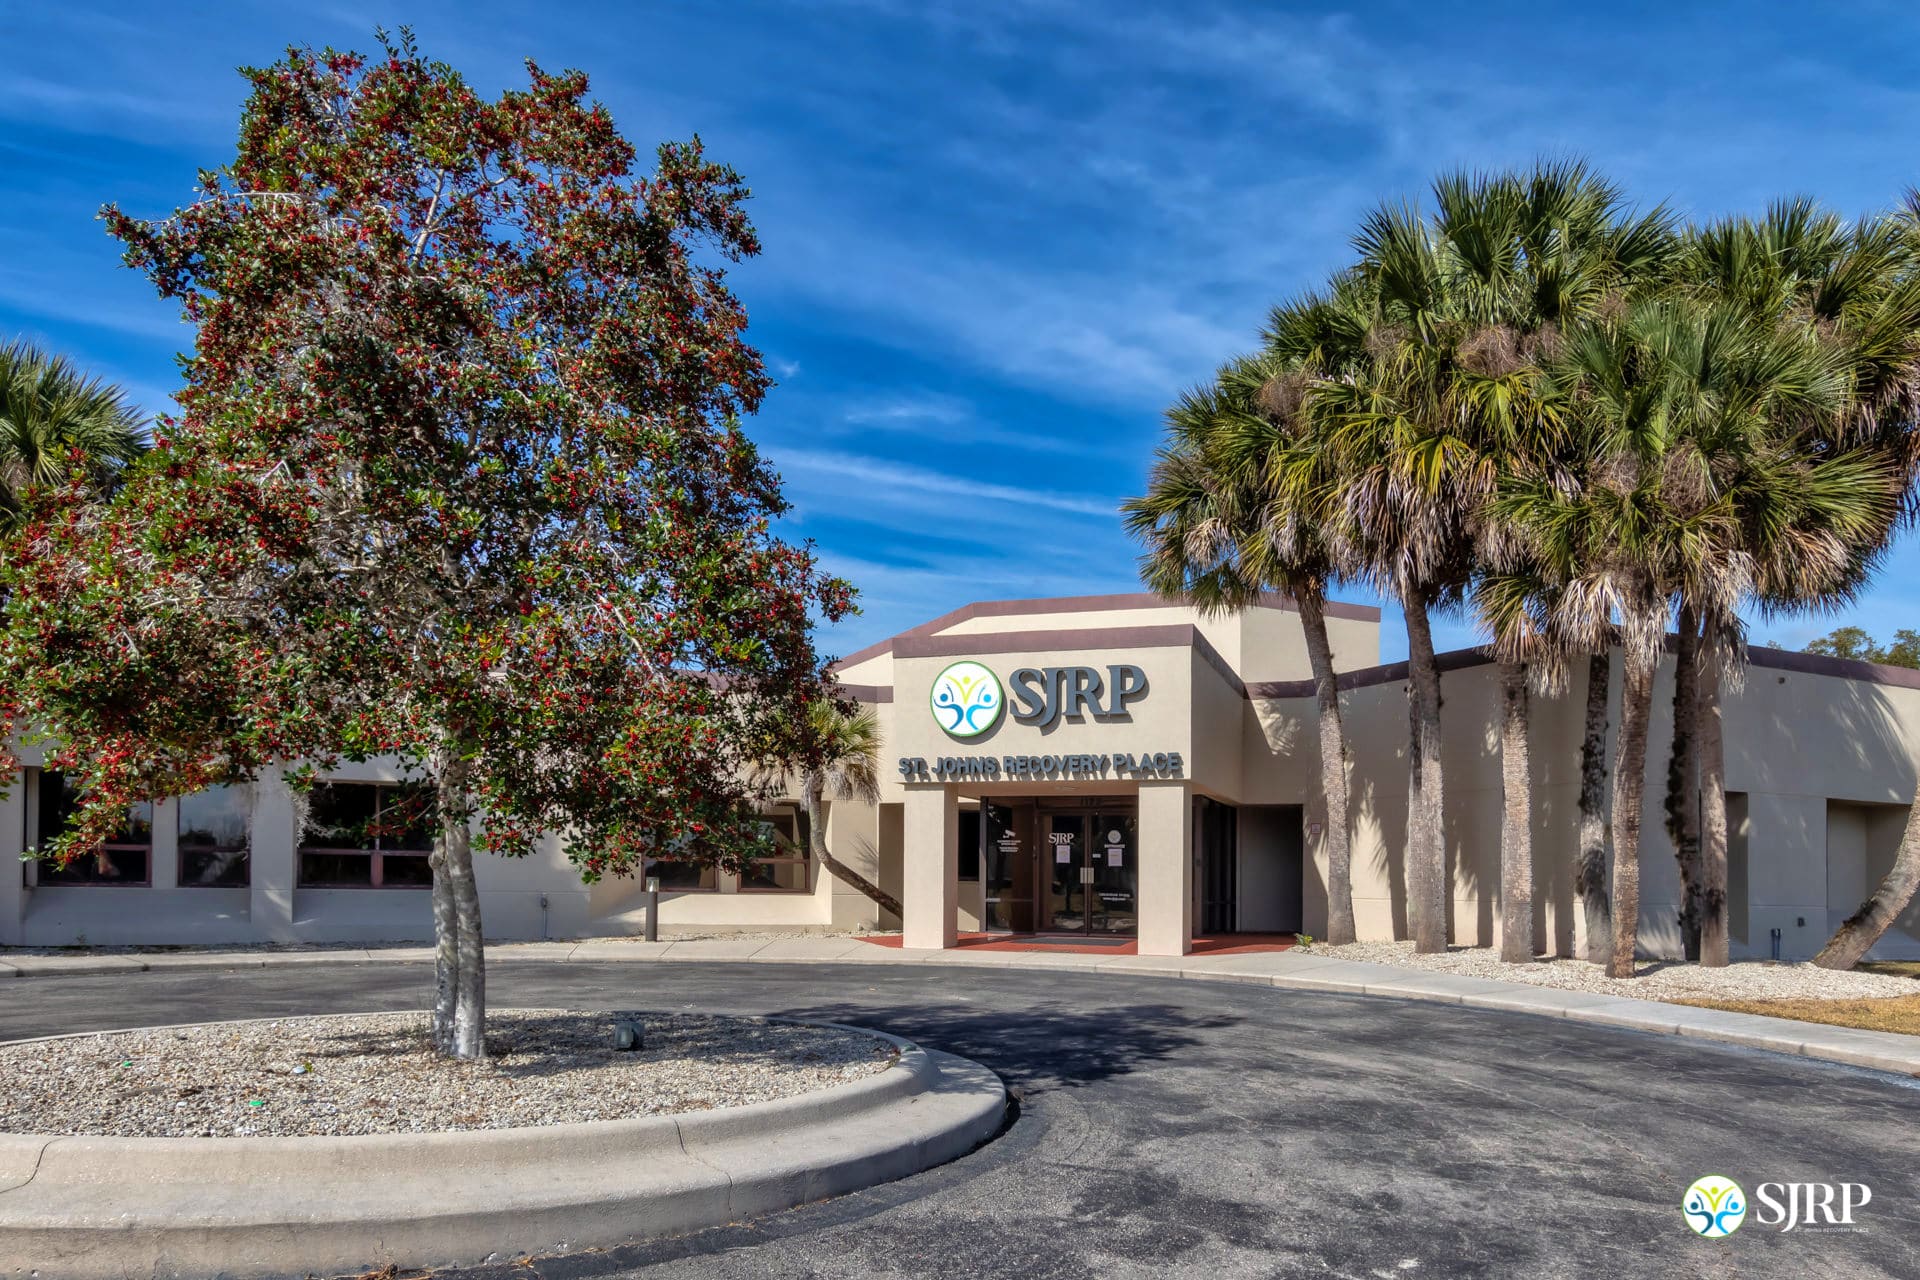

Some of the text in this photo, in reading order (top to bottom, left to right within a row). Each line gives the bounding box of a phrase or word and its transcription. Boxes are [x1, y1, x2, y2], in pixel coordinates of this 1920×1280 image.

[1009, 664, 1147, 727] SJRP
[898, 752, 1181, 775] ST. JOHNS RECOVERY PLACE
[1048, 832, 1074, 845] SJRP
